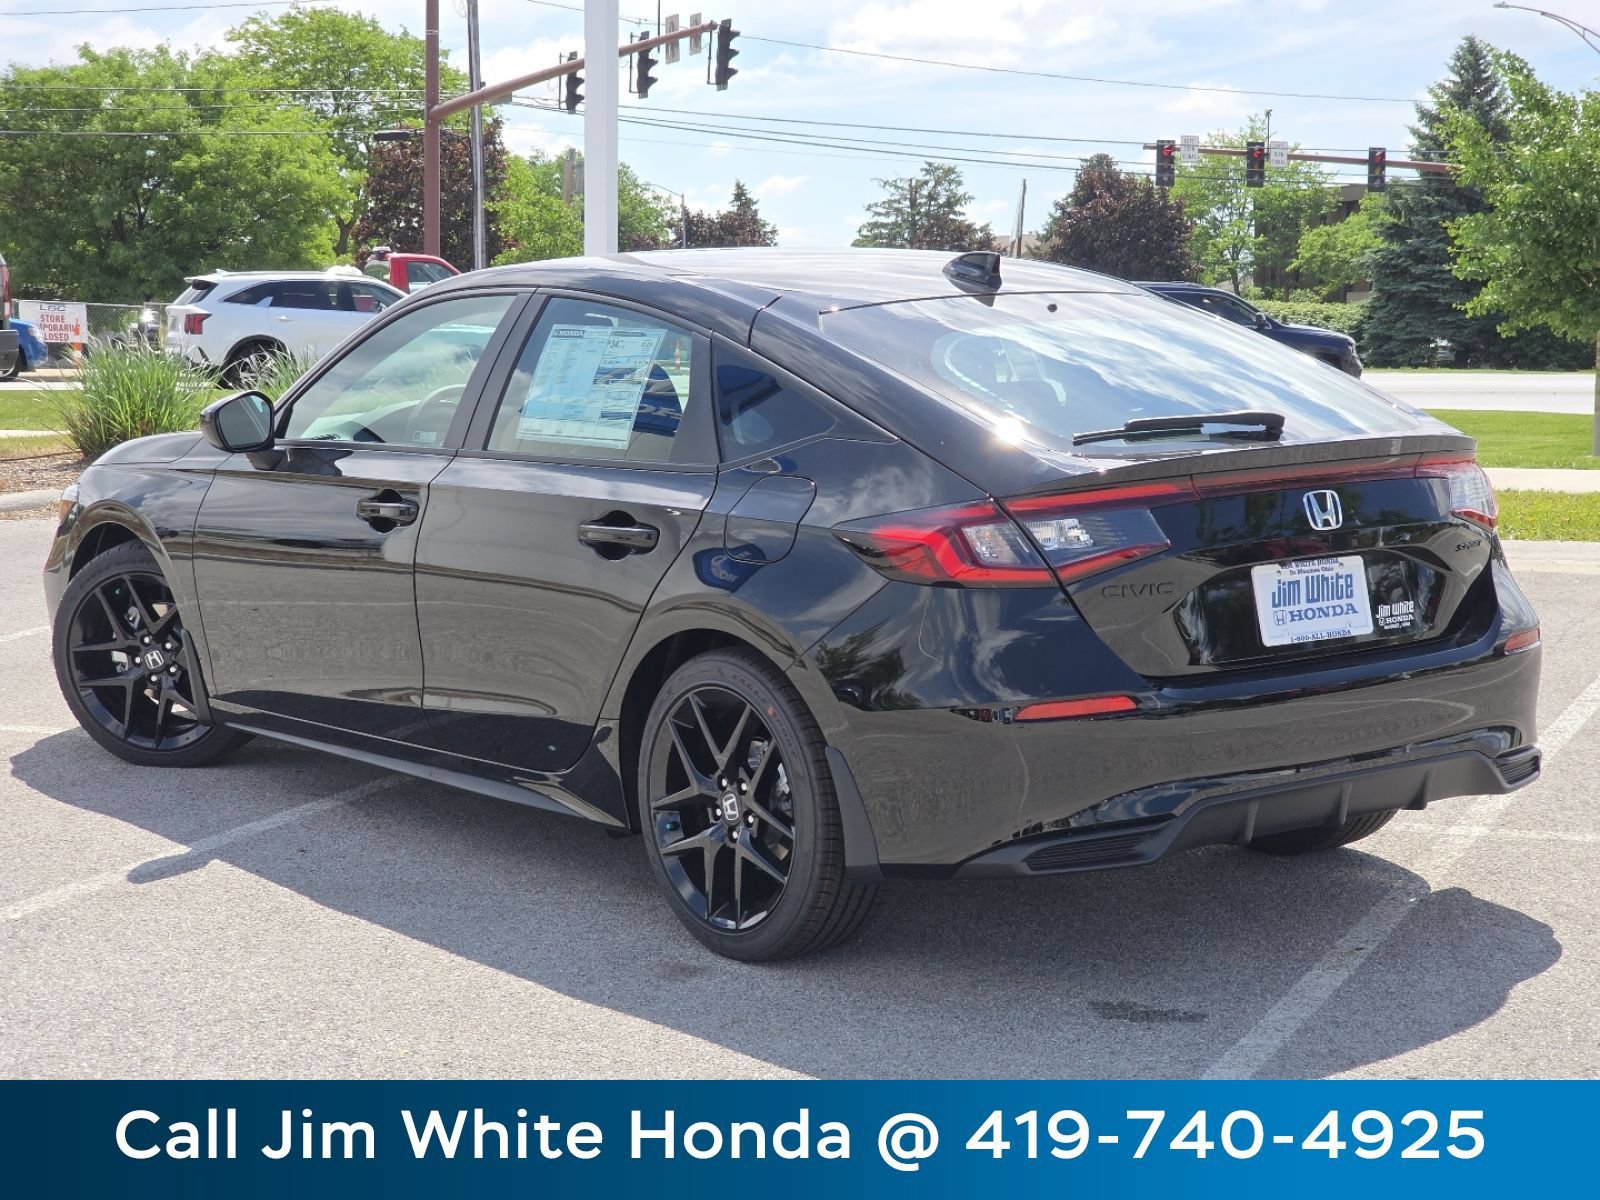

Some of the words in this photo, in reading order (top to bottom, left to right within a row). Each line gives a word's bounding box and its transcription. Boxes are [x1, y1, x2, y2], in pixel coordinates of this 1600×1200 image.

[40, 314, 66, 323] STORE
[42, 333, 69, 341] LOSED
[559, 329, 584, 338] HONDA
[1101, 581, 1174, 598] CIVIC
[1271, 574, 1301, 609] Jim
[1305, 572, 1354, 603] White
[1289, 603, 1359, 623] HONDA
[1375, 603, 1391, 618] Jim
[1391, 600, 1414, 616] White
